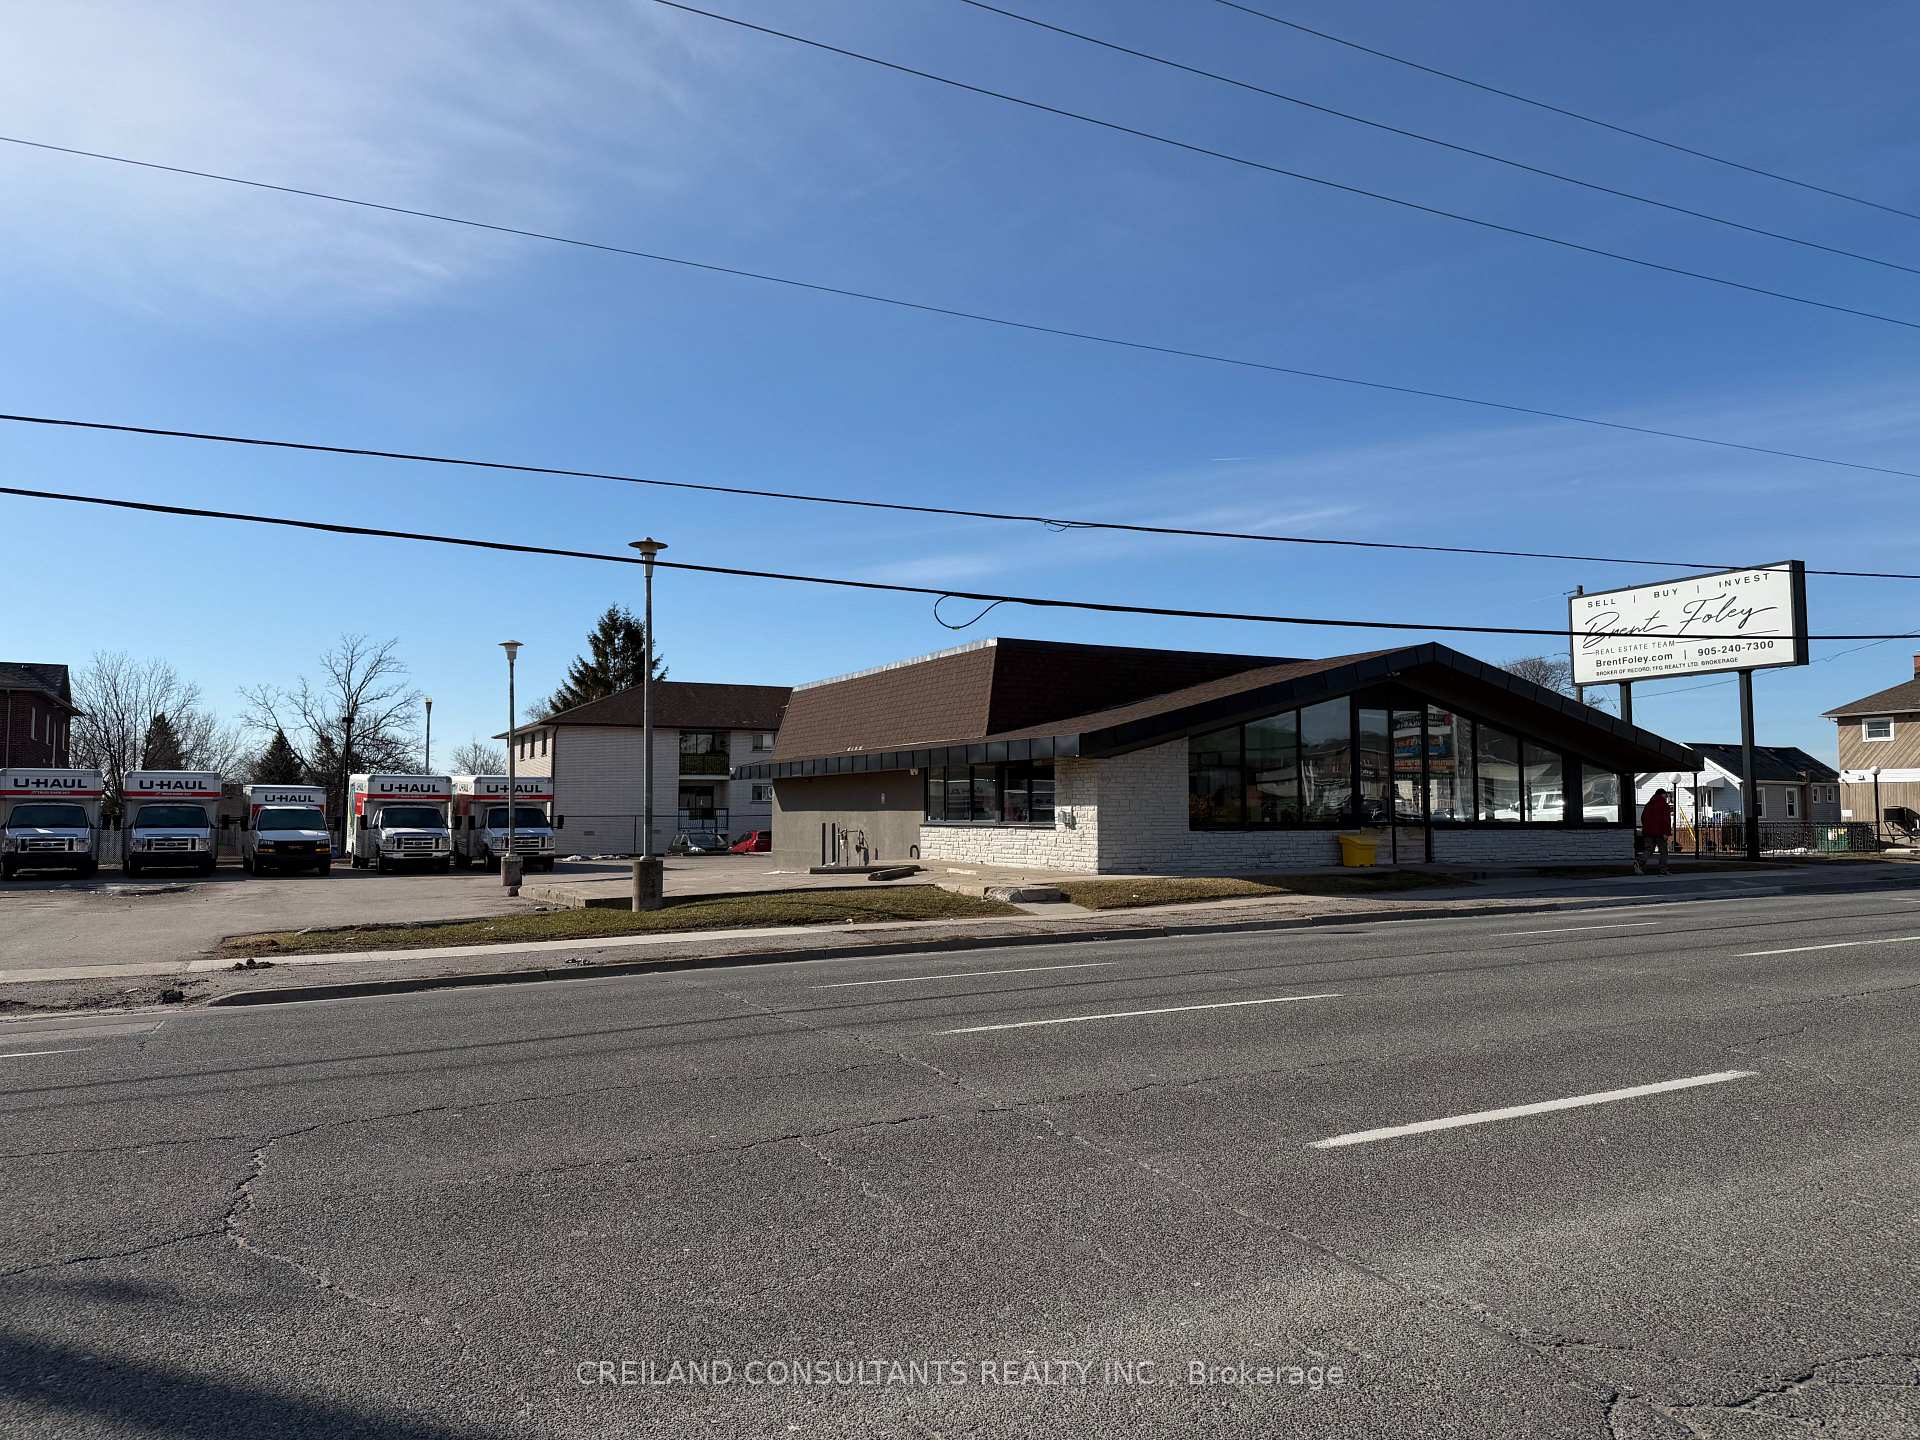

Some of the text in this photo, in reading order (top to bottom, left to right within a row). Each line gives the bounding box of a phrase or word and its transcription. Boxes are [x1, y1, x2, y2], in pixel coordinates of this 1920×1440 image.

[1587, 572, 1771, 608] SELL BUY INVEST
[1582, 593, 1778, 649] Brent Foley
[1595, 640, 1675, 656] REAL ESTATE TEAM
[1595, 640, 1774, 668] BrentFoley.com 905-240-7300
[1595, 669, 1617, 677] BROKER
[1664, 662, 1686, 670] REALTY
[1700, 657, 1738, 666] BROKERAGE
[13, 778, 88, 789] U-HAUL
[139, 780, 208, 790] U-HAUL
[380, 783, 440, 793] U-HAUL
[264, 793, 315, 803] U-HAUL
